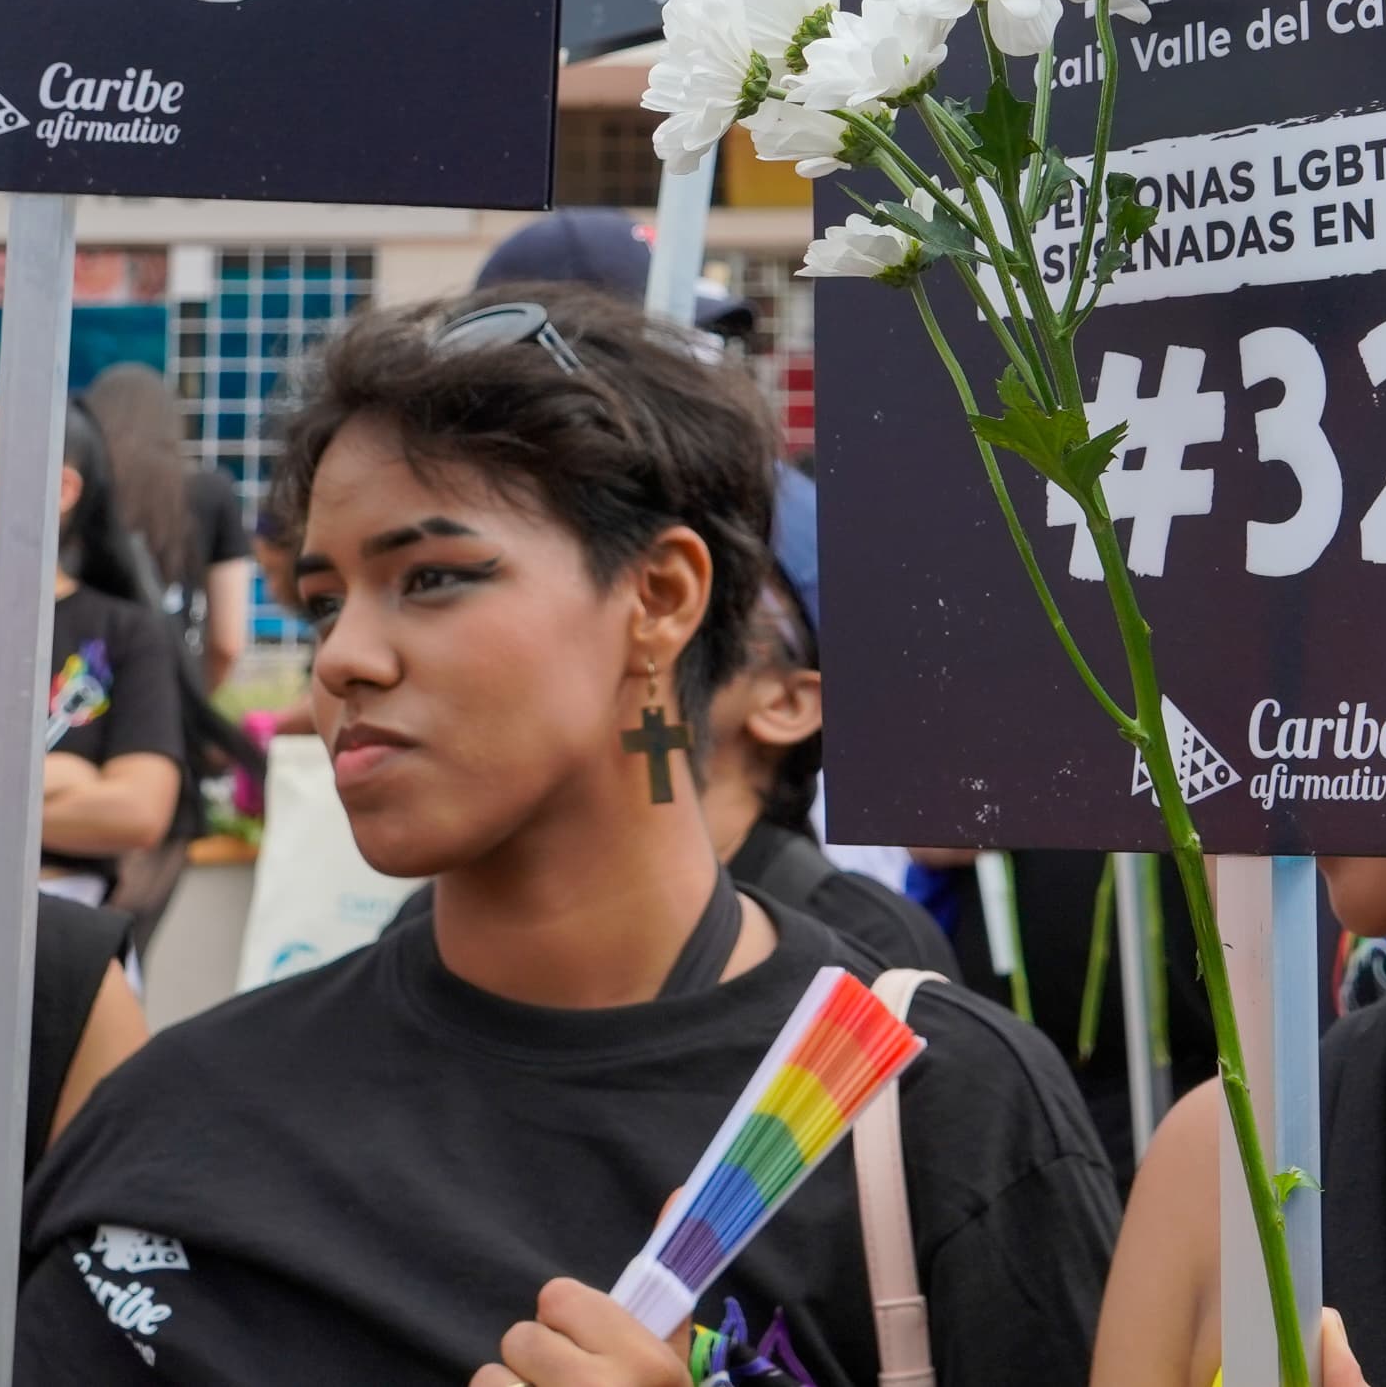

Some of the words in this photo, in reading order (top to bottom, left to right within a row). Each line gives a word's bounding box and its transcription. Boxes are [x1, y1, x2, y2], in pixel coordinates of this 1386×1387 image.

[1130, 20, 1231, 72] Valle
[1245, 0, 1310, 51] del
[38, 62, 185, 115] Caribe
[35, 110, 181, 148] afirmativo
[1031, 161, 1255, 234] ERONAS
[1038, 210, 1295, 284] SEINADAS
[1313, 198, 1375, 248] EN
